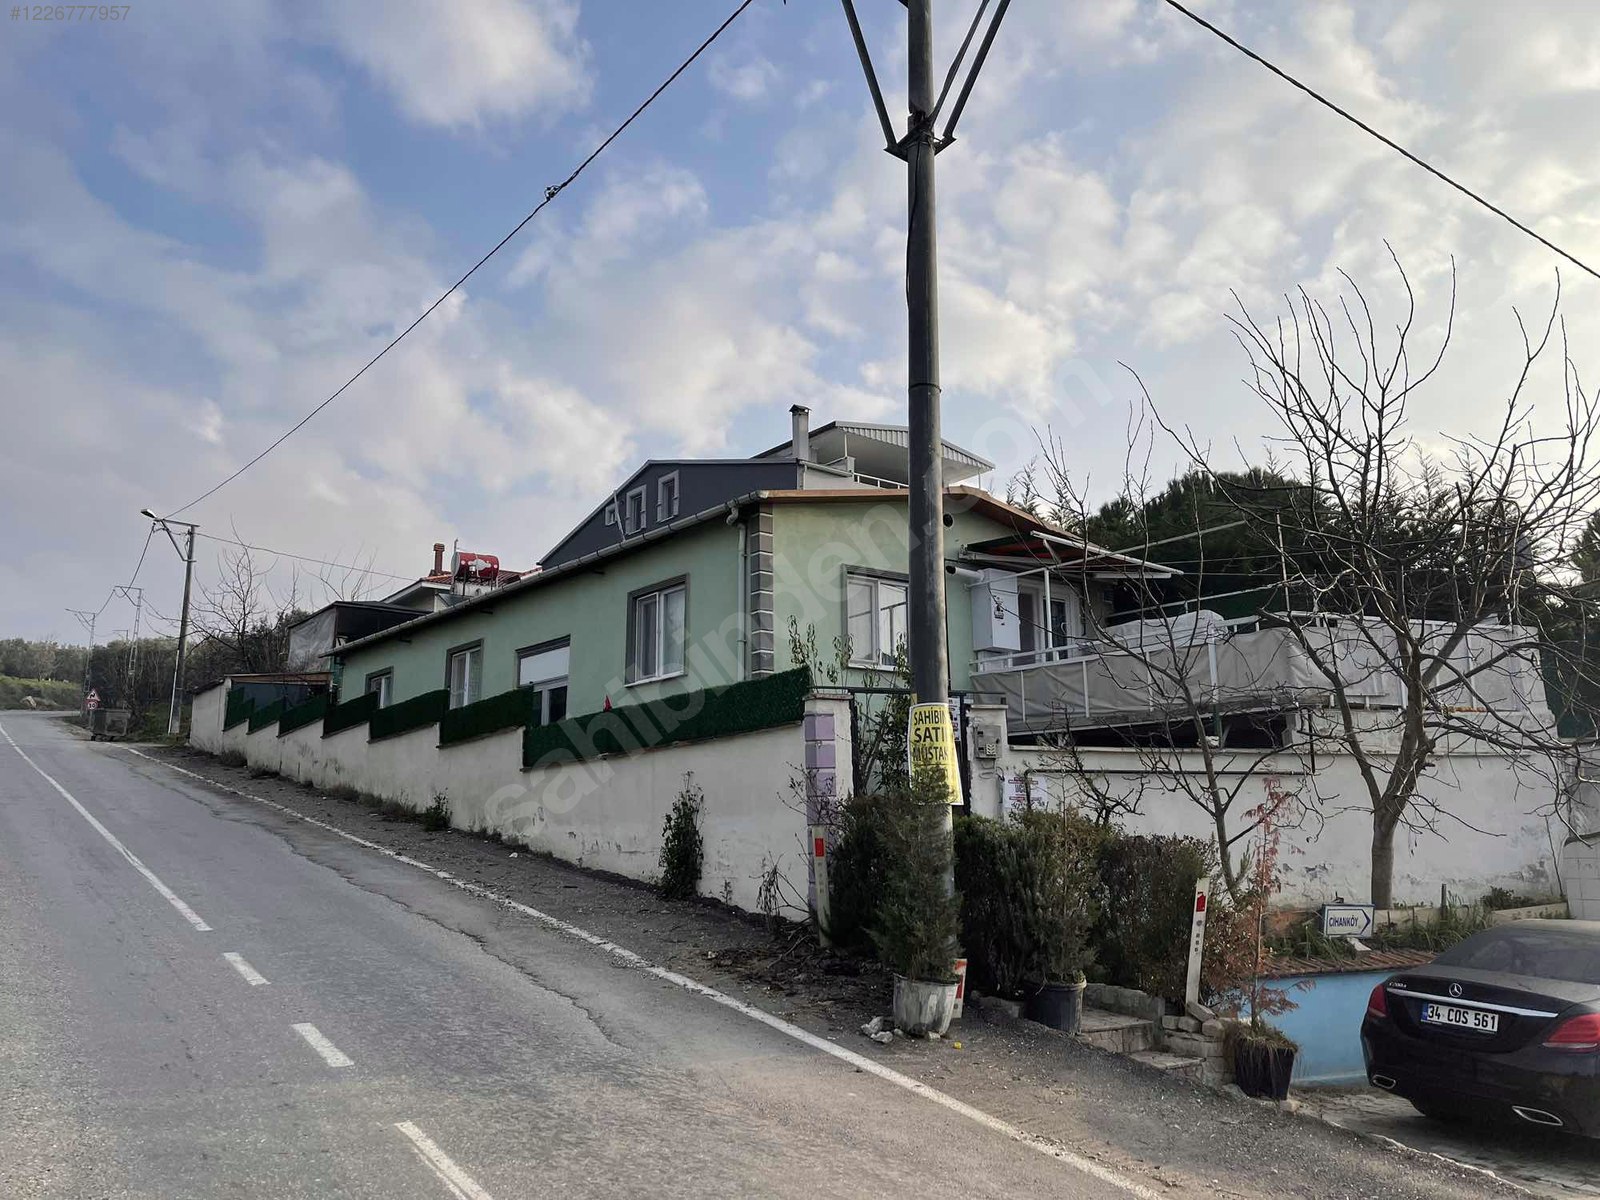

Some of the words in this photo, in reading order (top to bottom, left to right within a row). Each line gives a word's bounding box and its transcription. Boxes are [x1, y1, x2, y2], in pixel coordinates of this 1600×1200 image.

[1428, 1005, 1440, 1020] 34
[1447, 1008, 1469, 1024] COS
[1474, 1012, 1496, 1029] 561
